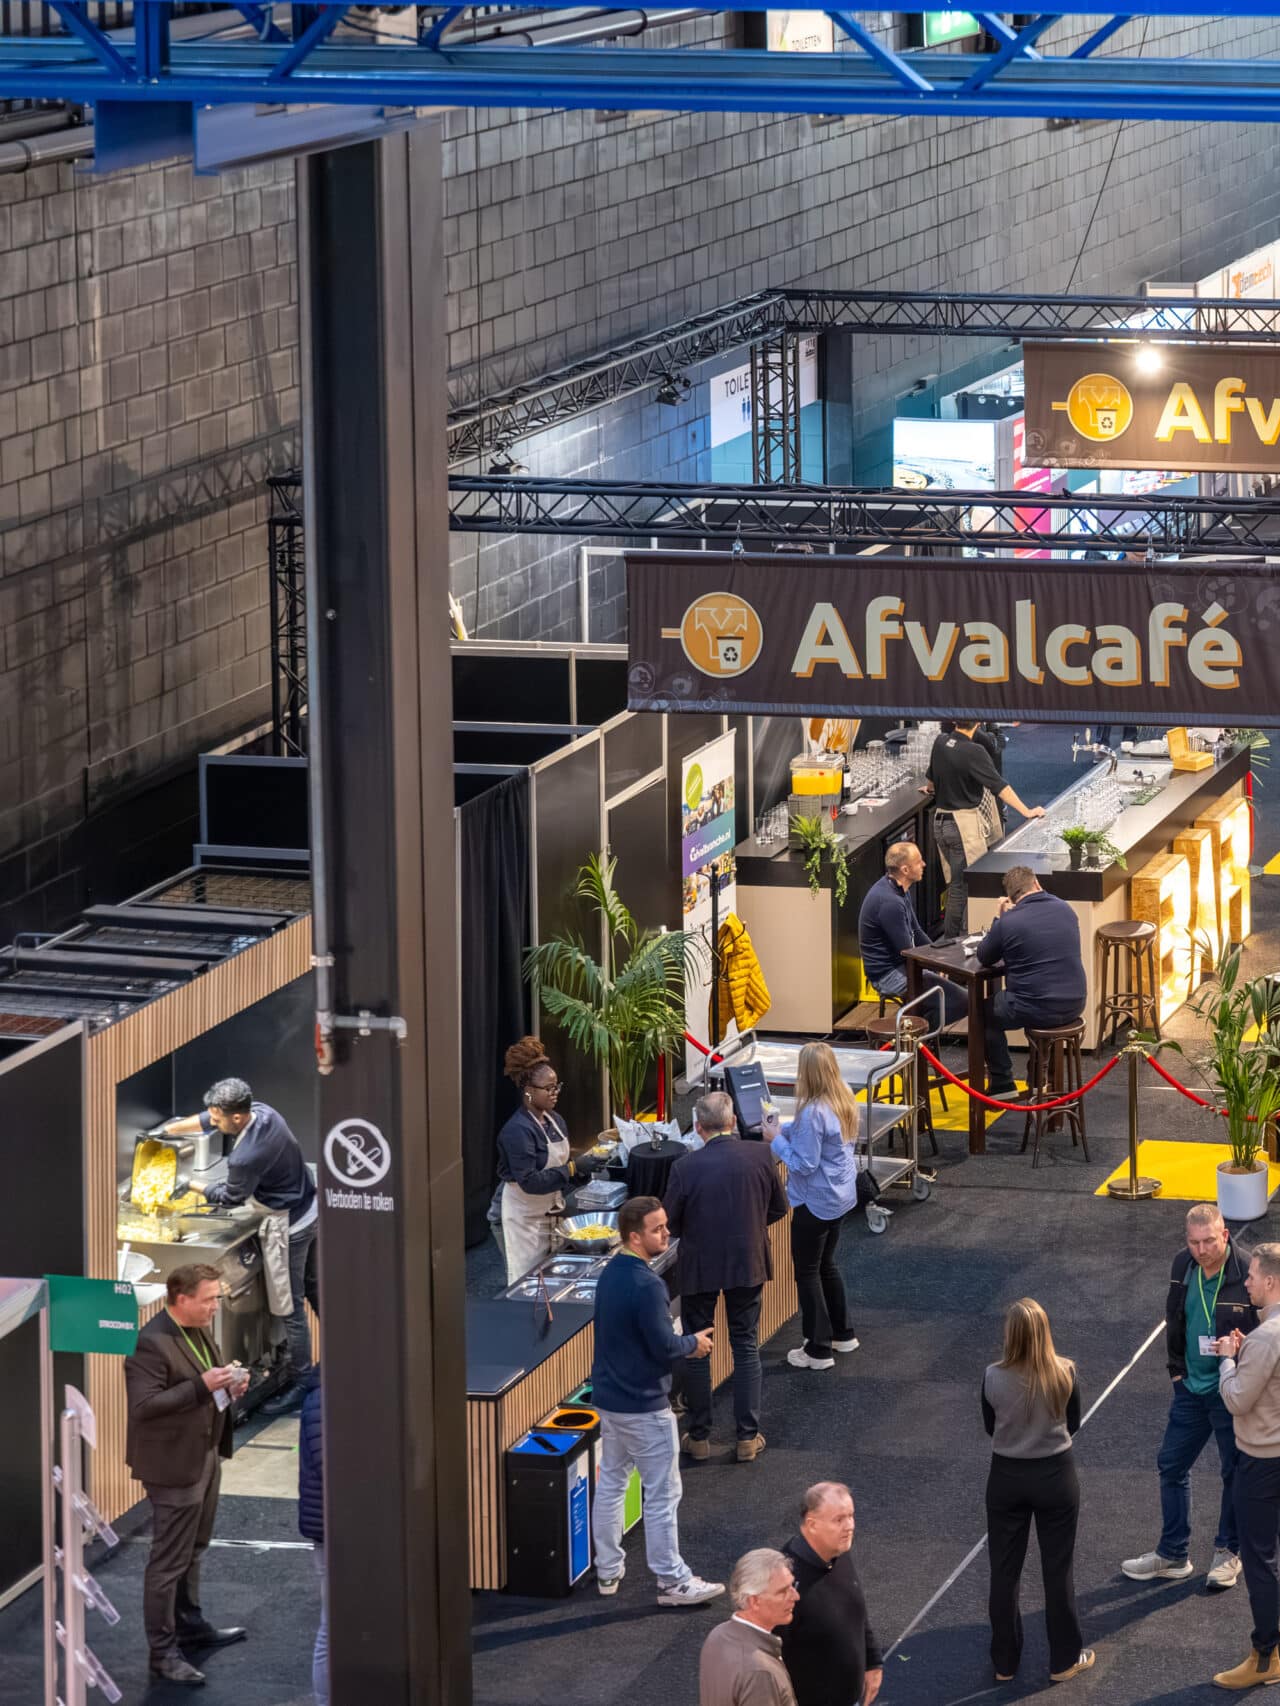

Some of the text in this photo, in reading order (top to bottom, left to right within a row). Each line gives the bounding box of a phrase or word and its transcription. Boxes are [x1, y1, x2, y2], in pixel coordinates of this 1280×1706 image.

[791, 595, 1242, 690] Afvalcafé
[325, 1188, 394, 1211] Verboden te roken
